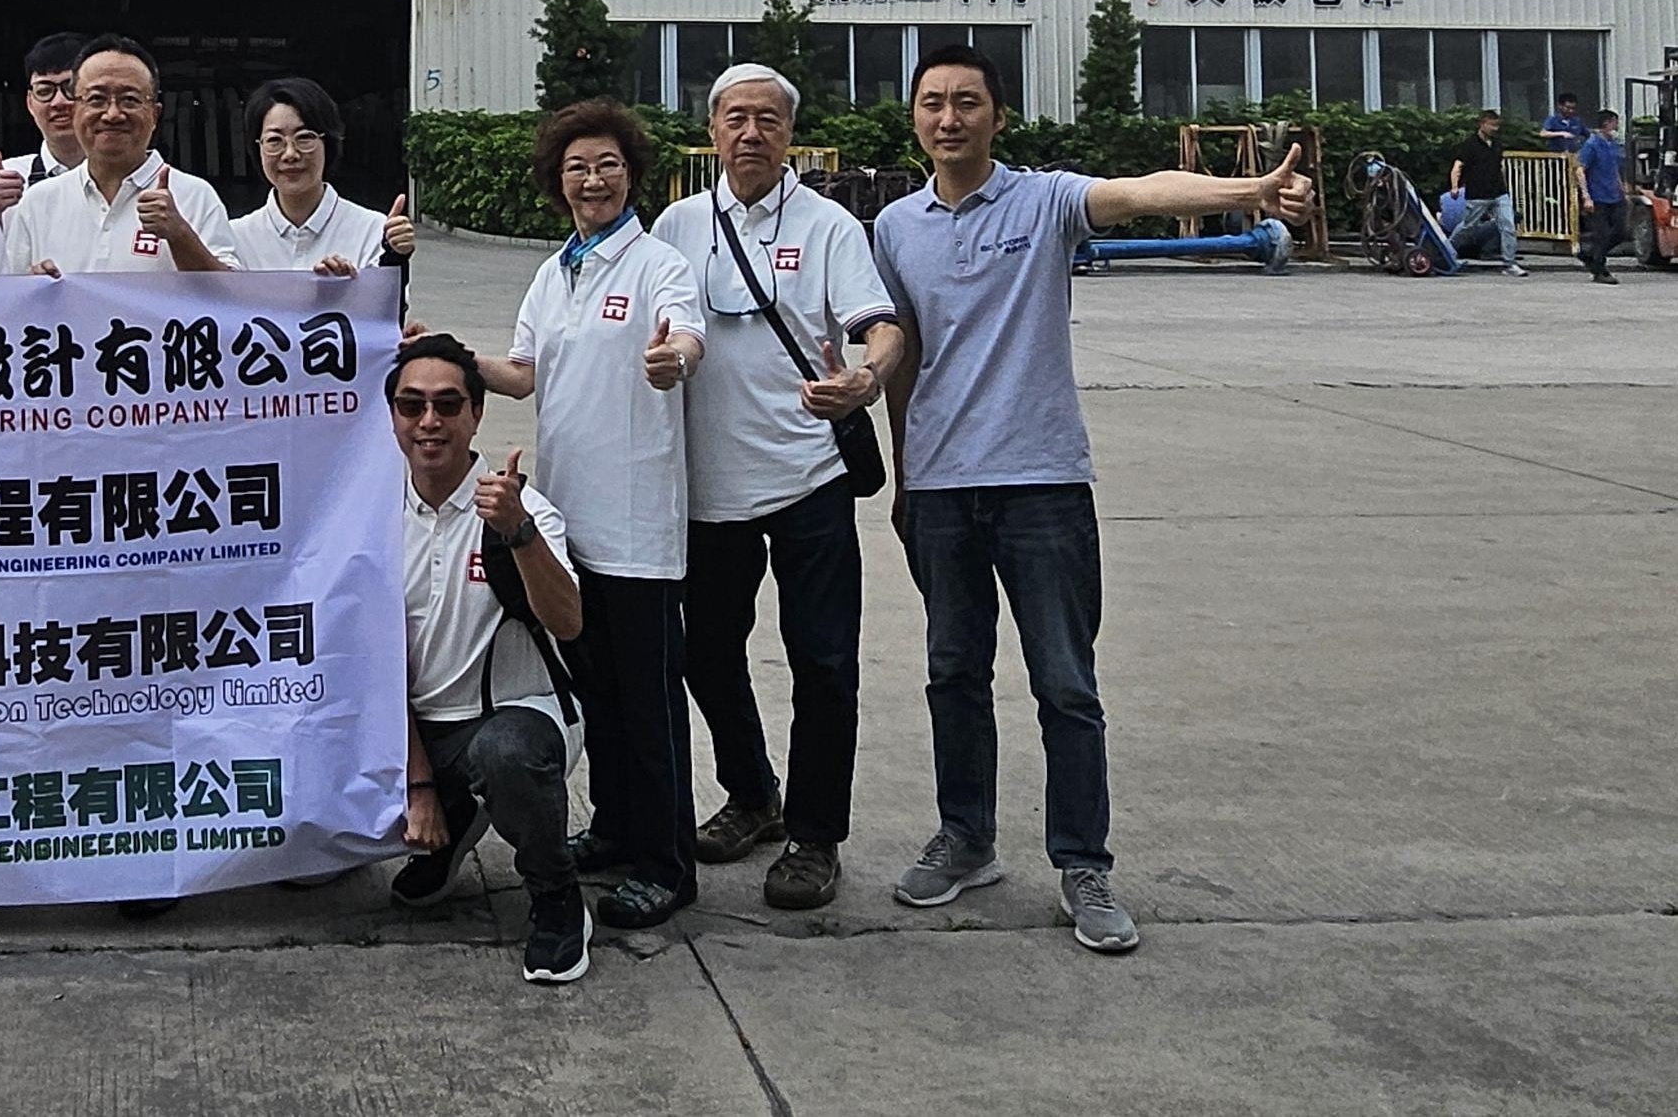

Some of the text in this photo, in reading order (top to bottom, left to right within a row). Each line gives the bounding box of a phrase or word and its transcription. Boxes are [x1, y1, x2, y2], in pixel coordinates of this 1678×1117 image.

[426, 69, 442, 91] 5
[87, 398, 229, 429] COMPANY
[244, 391, 360, 420] LIMITED
[116, 547, 205, 567] COMPANY
[211, 542, 282, 560] LIMITED
[35, 684, 215, 721] Technology
[222, 674, 324, 707] Limited
[186, 825, 286, 851] LIMITED
